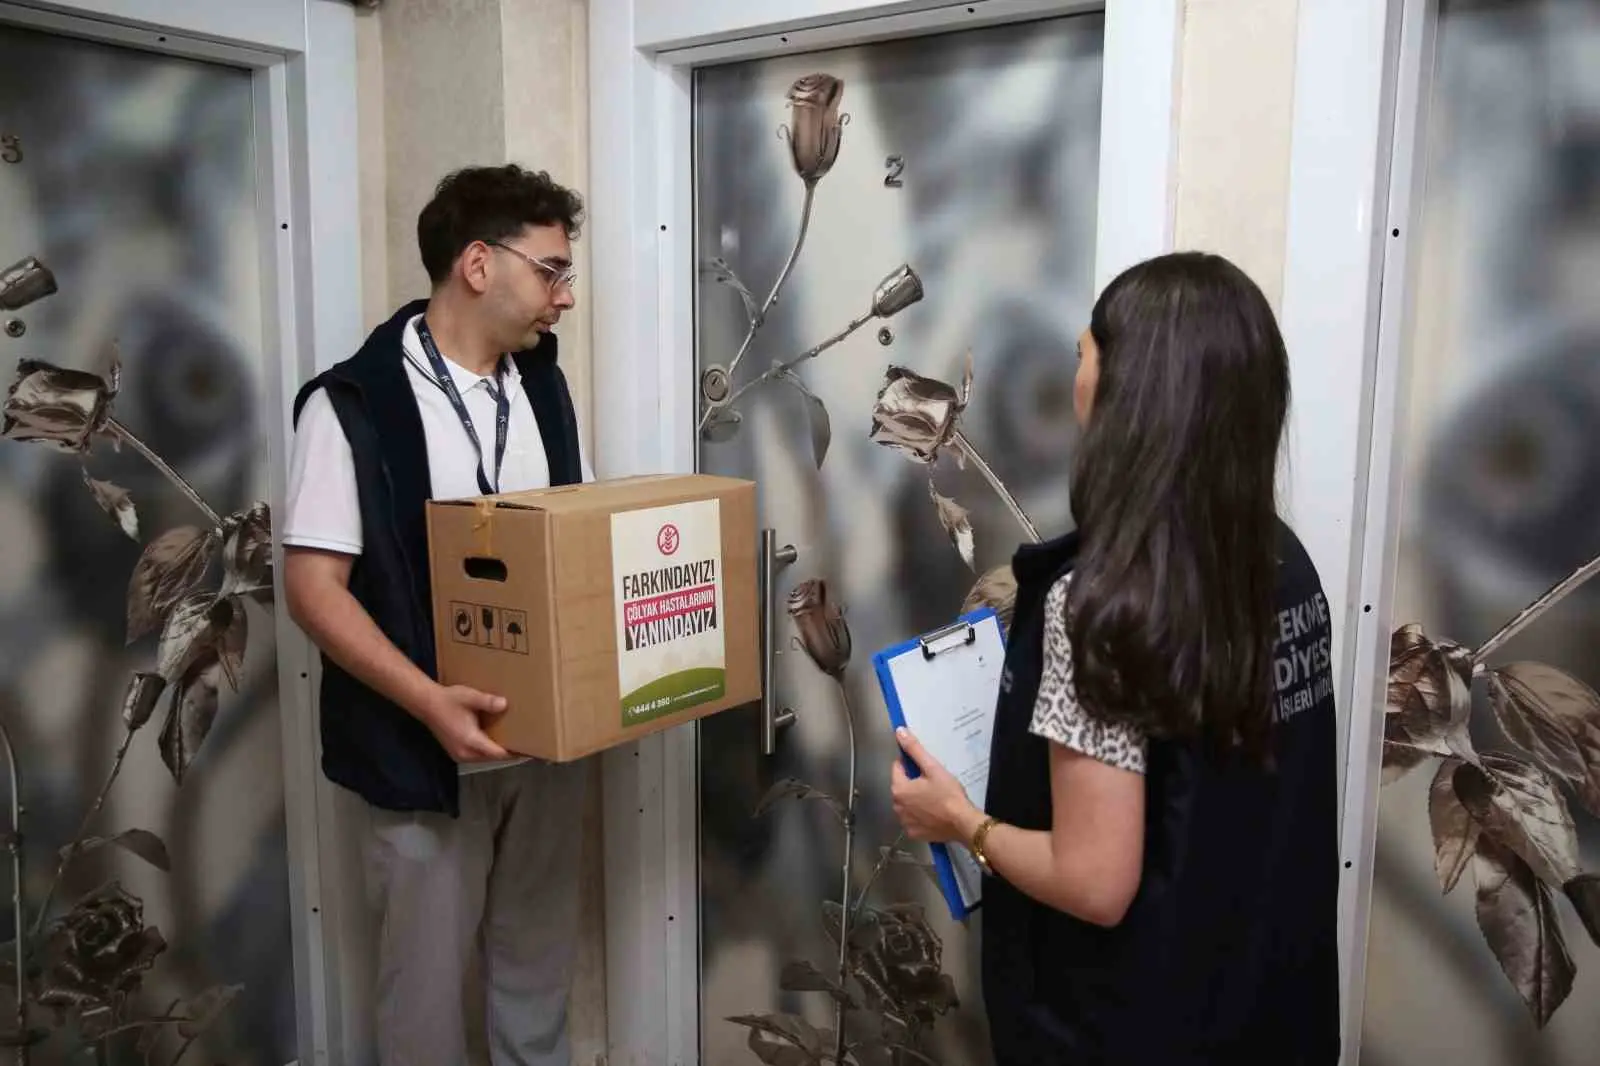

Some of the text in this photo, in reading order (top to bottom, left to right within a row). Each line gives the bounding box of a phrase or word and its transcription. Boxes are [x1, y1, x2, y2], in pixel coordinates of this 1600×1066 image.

[0, 133, 24, 164] 3
[884, 154, 905, 189] 2
[622, 559, 716, 600] FARKINDAYIZ!
[626, 590, 714, 624] ÇÖLYAK HASTALARININ
[1274, 592, 1329, 645] EKME
[627, 606, 714, 651] YANINDAYIZ
